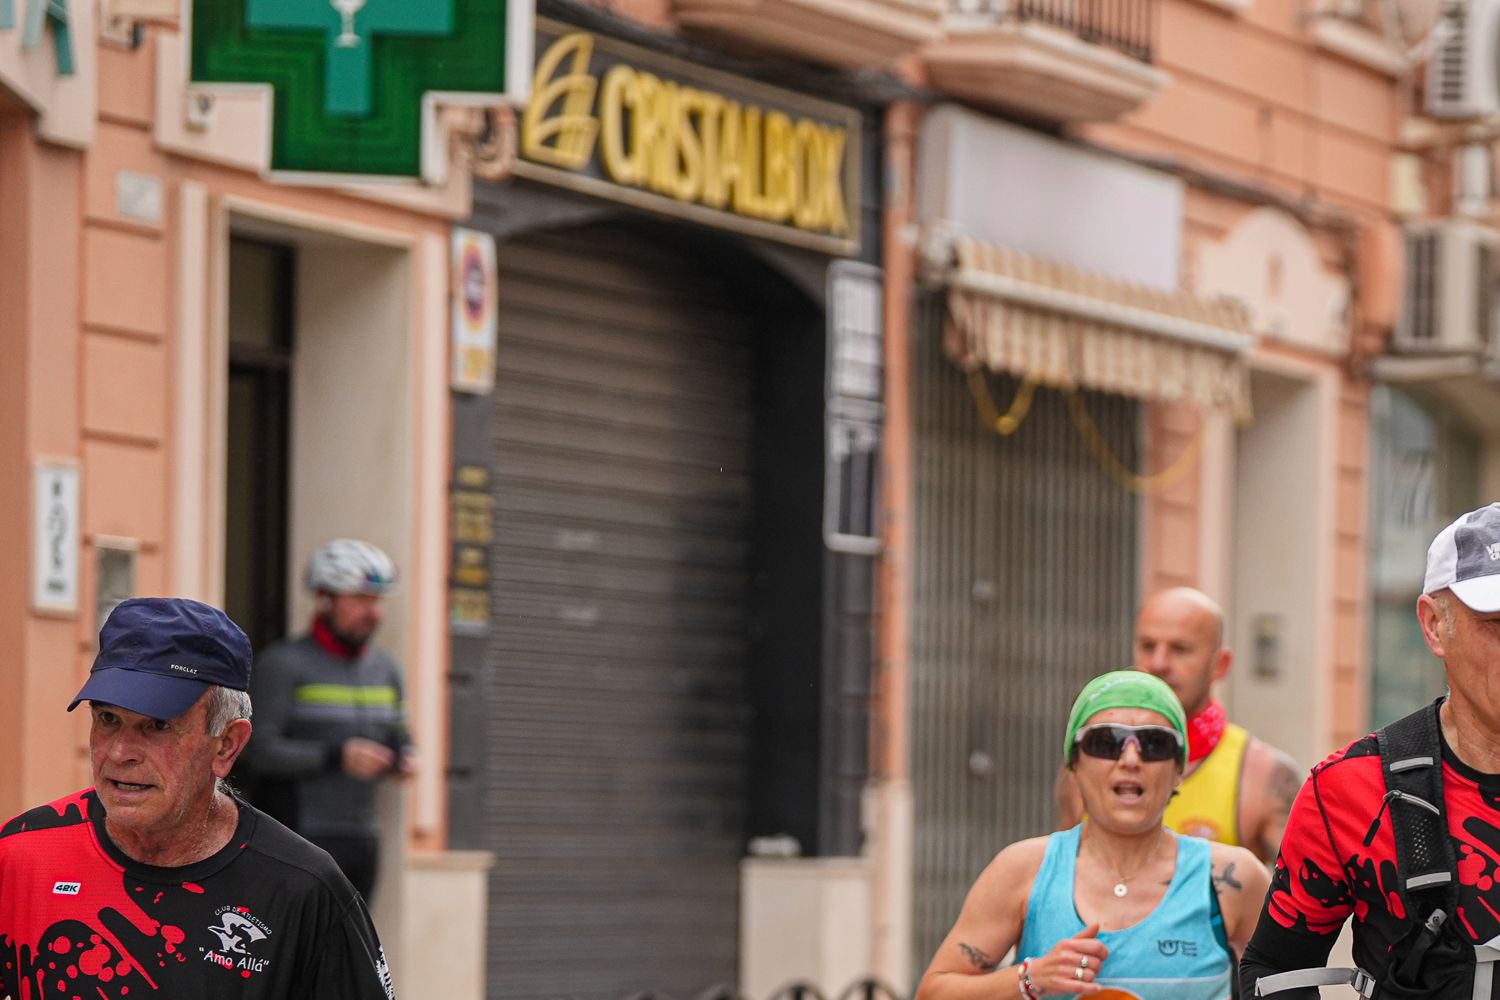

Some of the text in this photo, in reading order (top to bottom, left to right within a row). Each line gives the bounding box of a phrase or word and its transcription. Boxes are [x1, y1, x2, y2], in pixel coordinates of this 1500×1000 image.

[603, 64, 848, 232] CRISTALBOX
[170, 664, 198, 675] FORCLAZ
[214, 905, 231, 916] CLUB
[241, 911, 273, 935] ATLETISMO
